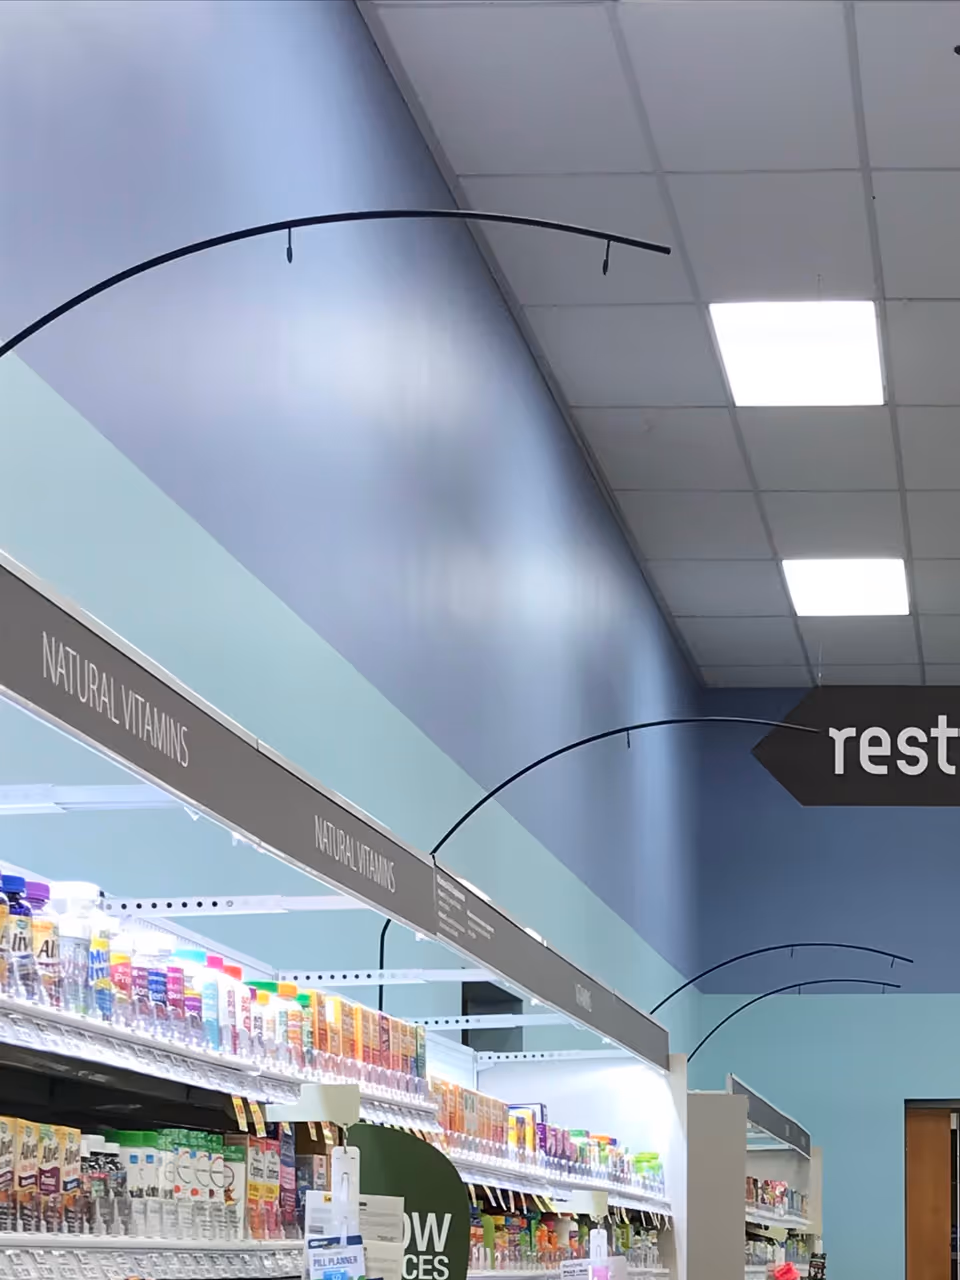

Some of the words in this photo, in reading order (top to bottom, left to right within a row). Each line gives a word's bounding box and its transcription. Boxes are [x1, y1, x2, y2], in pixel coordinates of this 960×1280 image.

[42, 630, 120, 725] NATURAL
[121, 684, 189, 768] VITAMINS
[314, 814, 357, 872] NATURAL
[356, 841, 396, 893] VITAMINS
[313, 1256, 328, 1268] PILL
[328, 1254, 358, 1267] PLANNER
[402, 1254, 449, 1280] CES
